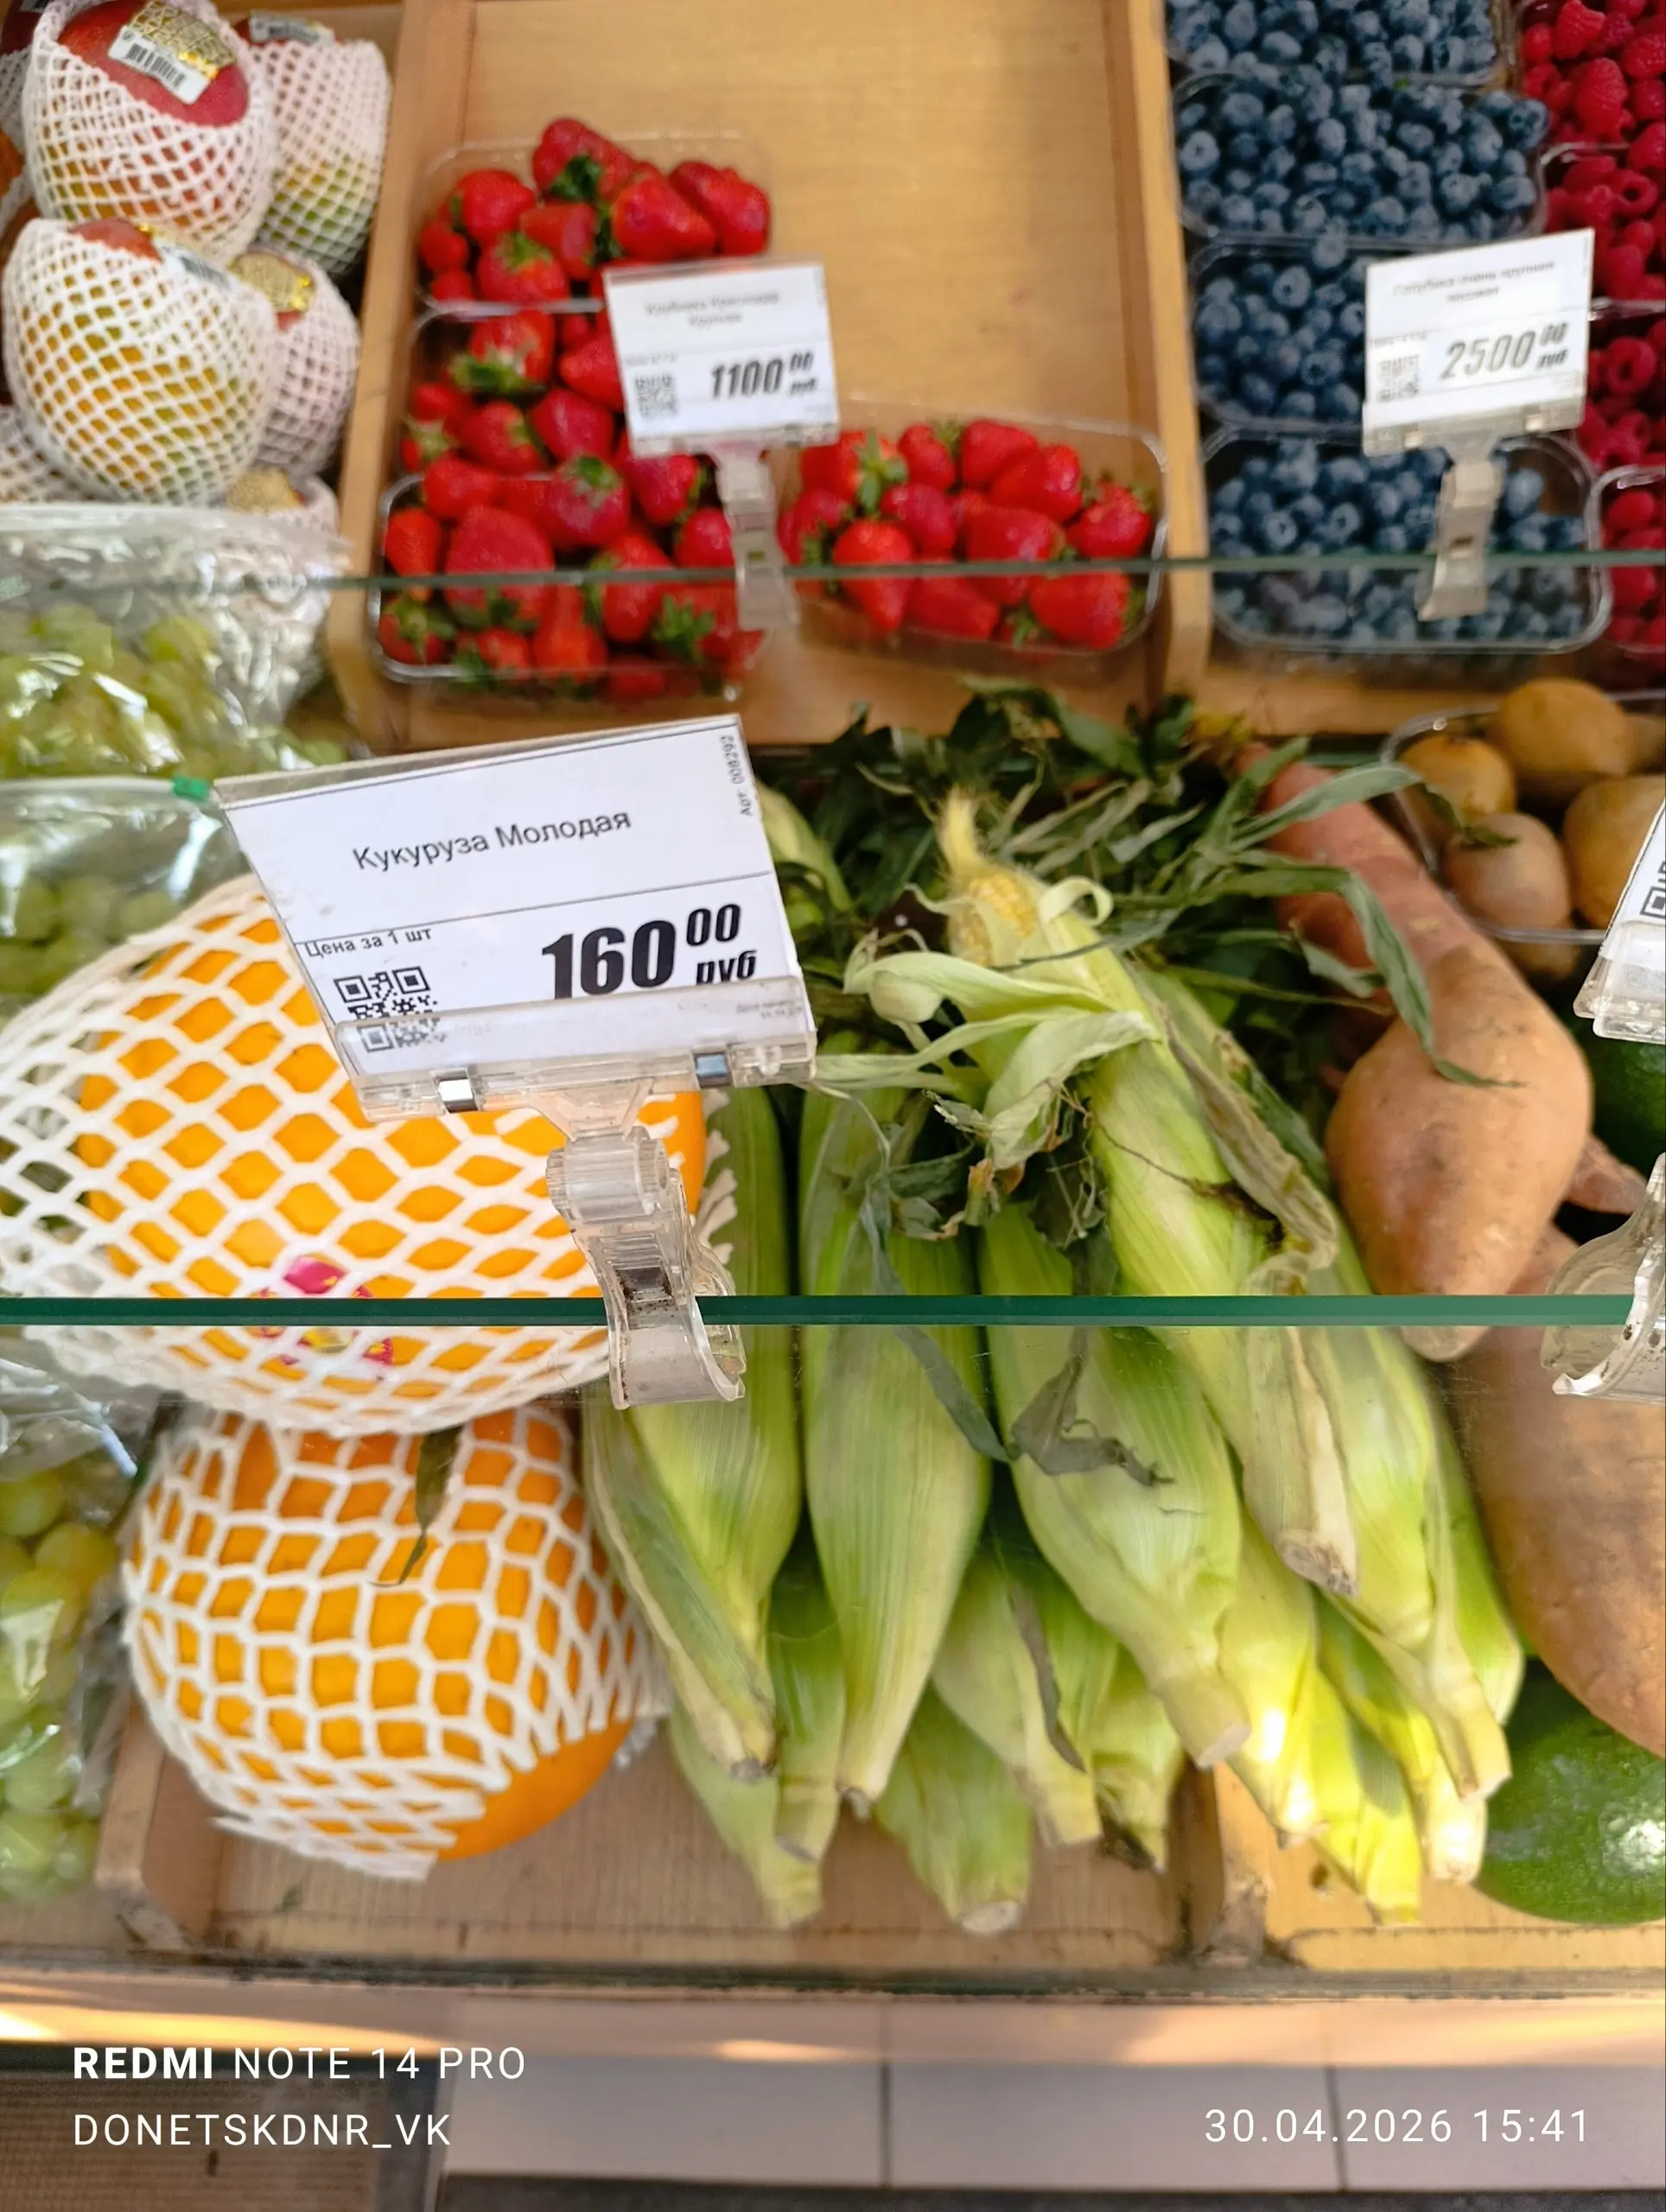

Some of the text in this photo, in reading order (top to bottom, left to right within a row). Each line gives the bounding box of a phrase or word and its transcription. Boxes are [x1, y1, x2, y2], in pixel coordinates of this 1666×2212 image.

[710, 357, 783, 399] 1100
[789, 351, 815, 372] 00
[1440, 321, 1569, 380] 2500 00
[720, 734, 746, 785] 008292
[352, 811, 633, 873] Кукуруза Молодая
[304, 927, 432, 959] Цена за 1 шт
[541, 903, 742, 1000] 160 00
